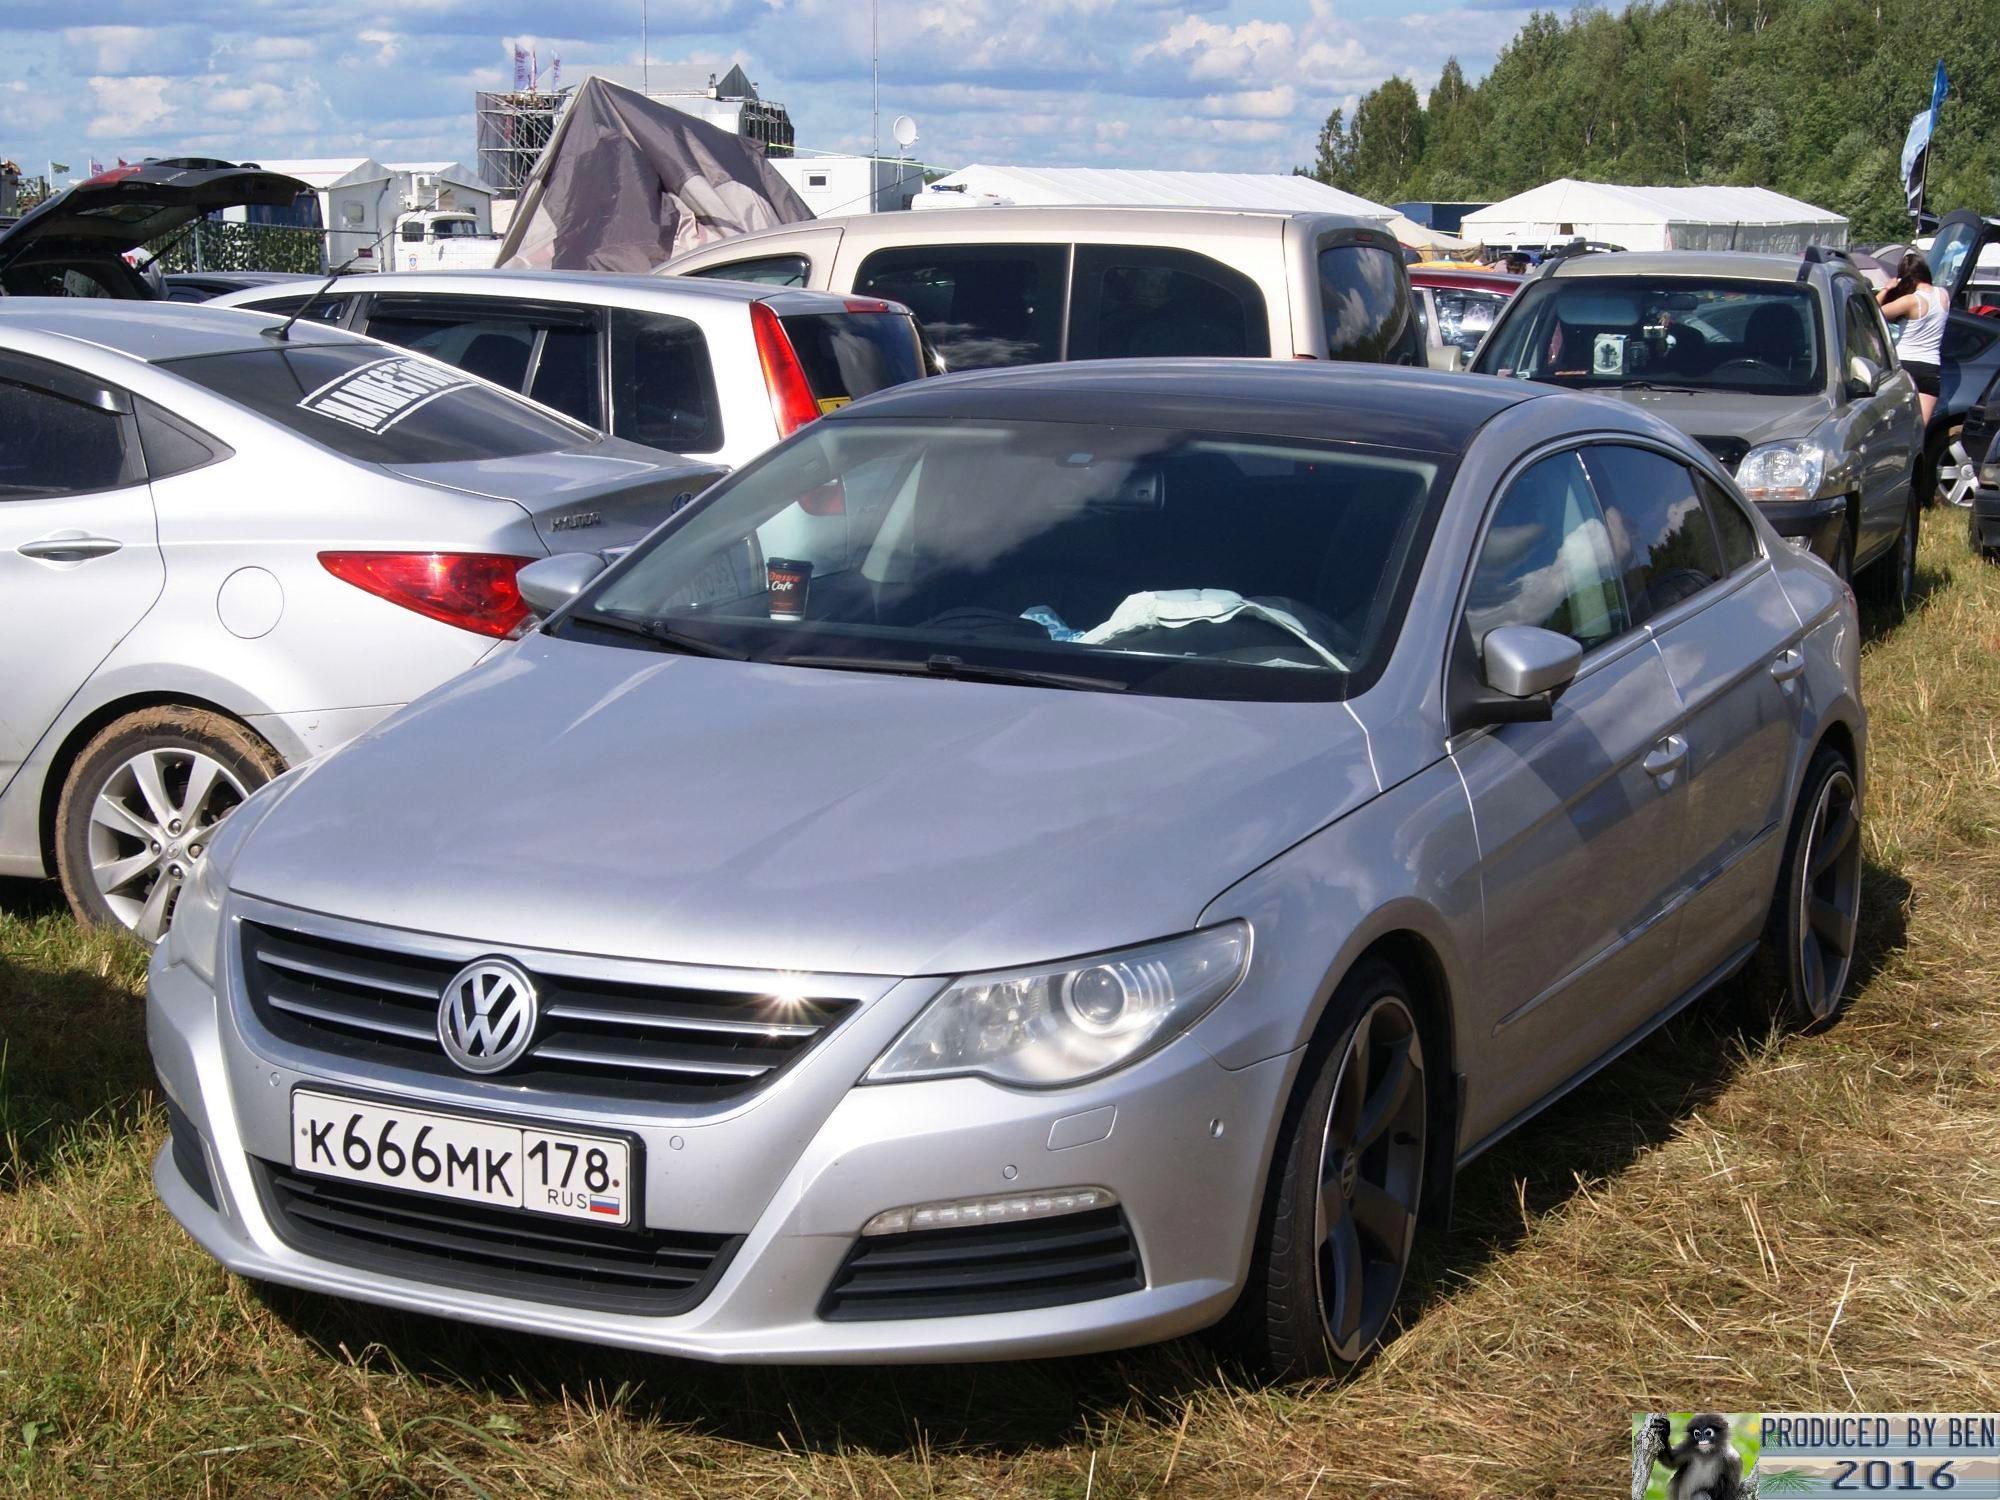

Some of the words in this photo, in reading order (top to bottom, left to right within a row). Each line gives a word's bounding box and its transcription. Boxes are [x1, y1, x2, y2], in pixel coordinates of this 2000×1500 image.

[310, 1113, 514, 1198] K666MK
[527, 1139, 610, 1193] 178
[547, 1188, 588, 1210] RUS
